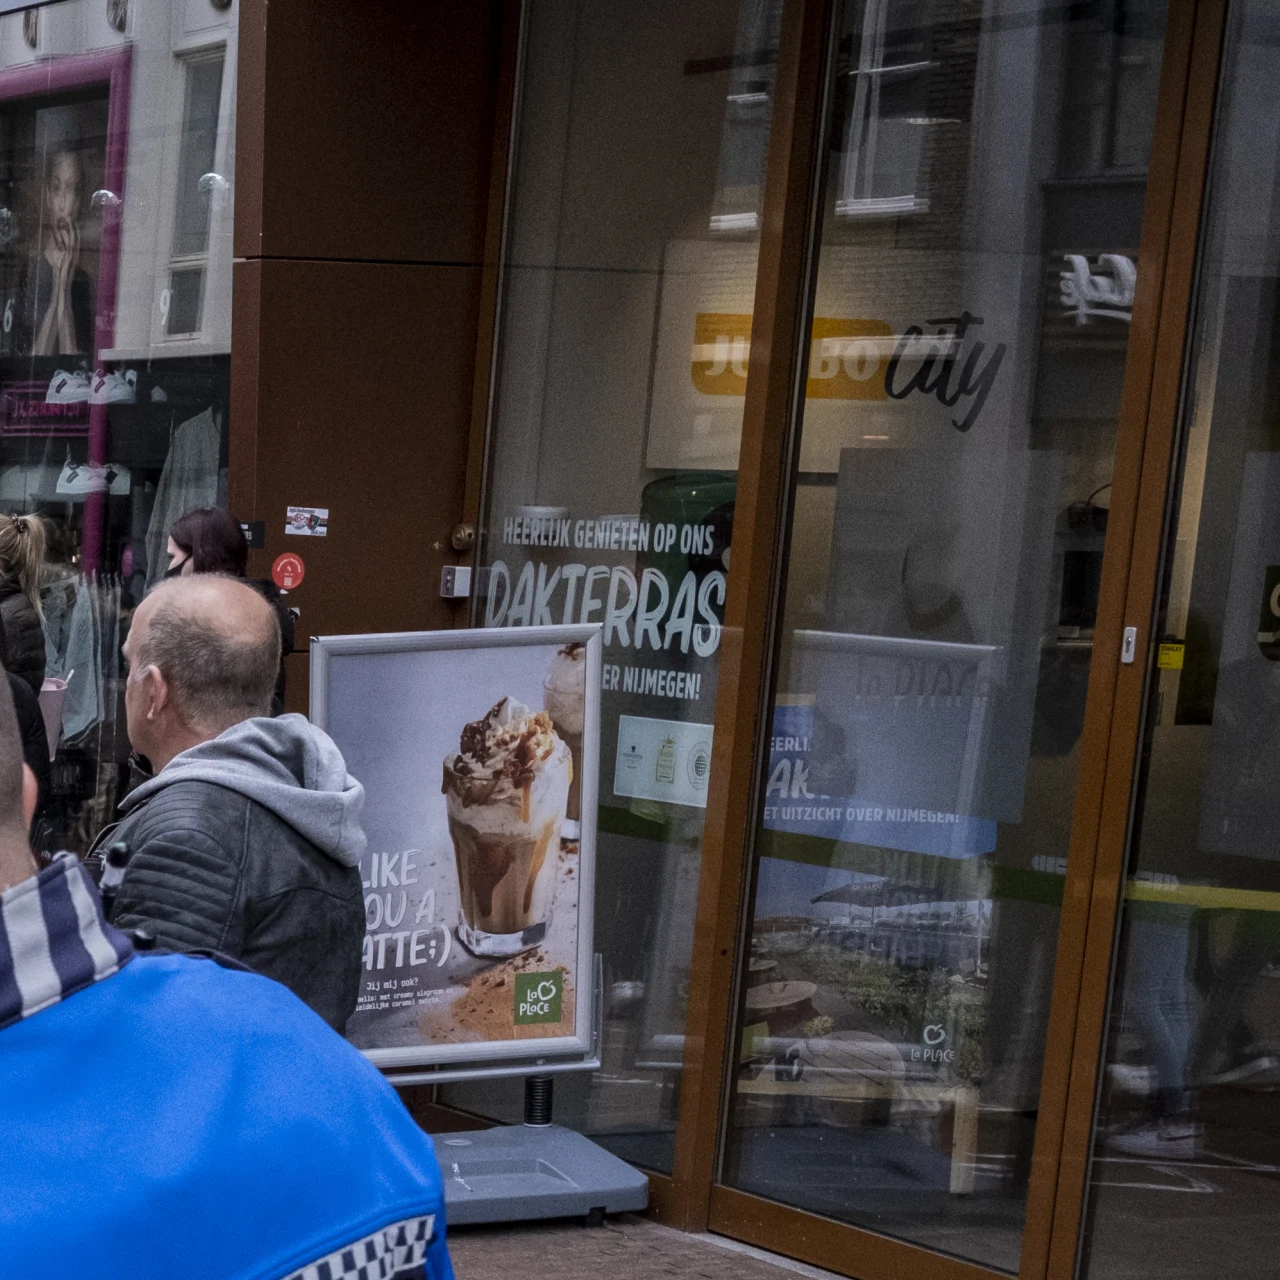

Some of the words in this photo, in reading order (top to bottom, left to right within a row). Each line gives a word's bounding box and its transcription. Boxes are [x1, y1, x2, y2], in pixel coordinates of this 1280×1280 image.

[704, 334, 880, 382] JUBO
[503, 517, 571, 547] HEERLIJK
[574, 520, 650, 552] GENIETEN
[654, 523, 677, 553] OP
[680, 524, 716, 555] ONS
[484, 560, 726, 658] DAKTERRAS
[602, 665, 620, 690] ER
[624, 666, 701, 700] NIJMEGEN!
[764, 807, 778, 820] ET
[781, 806, 841, 821] UITZICHT
[846, 808, 883, 822] OVER
[886, 808, 960, 824] NIJMEGEN!
[365, 890, 407, 930] OU
[415, 888, 436, 924] A
[362, 924, 452, 971] ATTE;)
[366, 981, 380, 991] Jij
[383, 980, 397, 989] mij
[400, 978, 419, 987] ook?
[528, 989, 538, 1002] La
[911, 1048, 920, 1062] La
